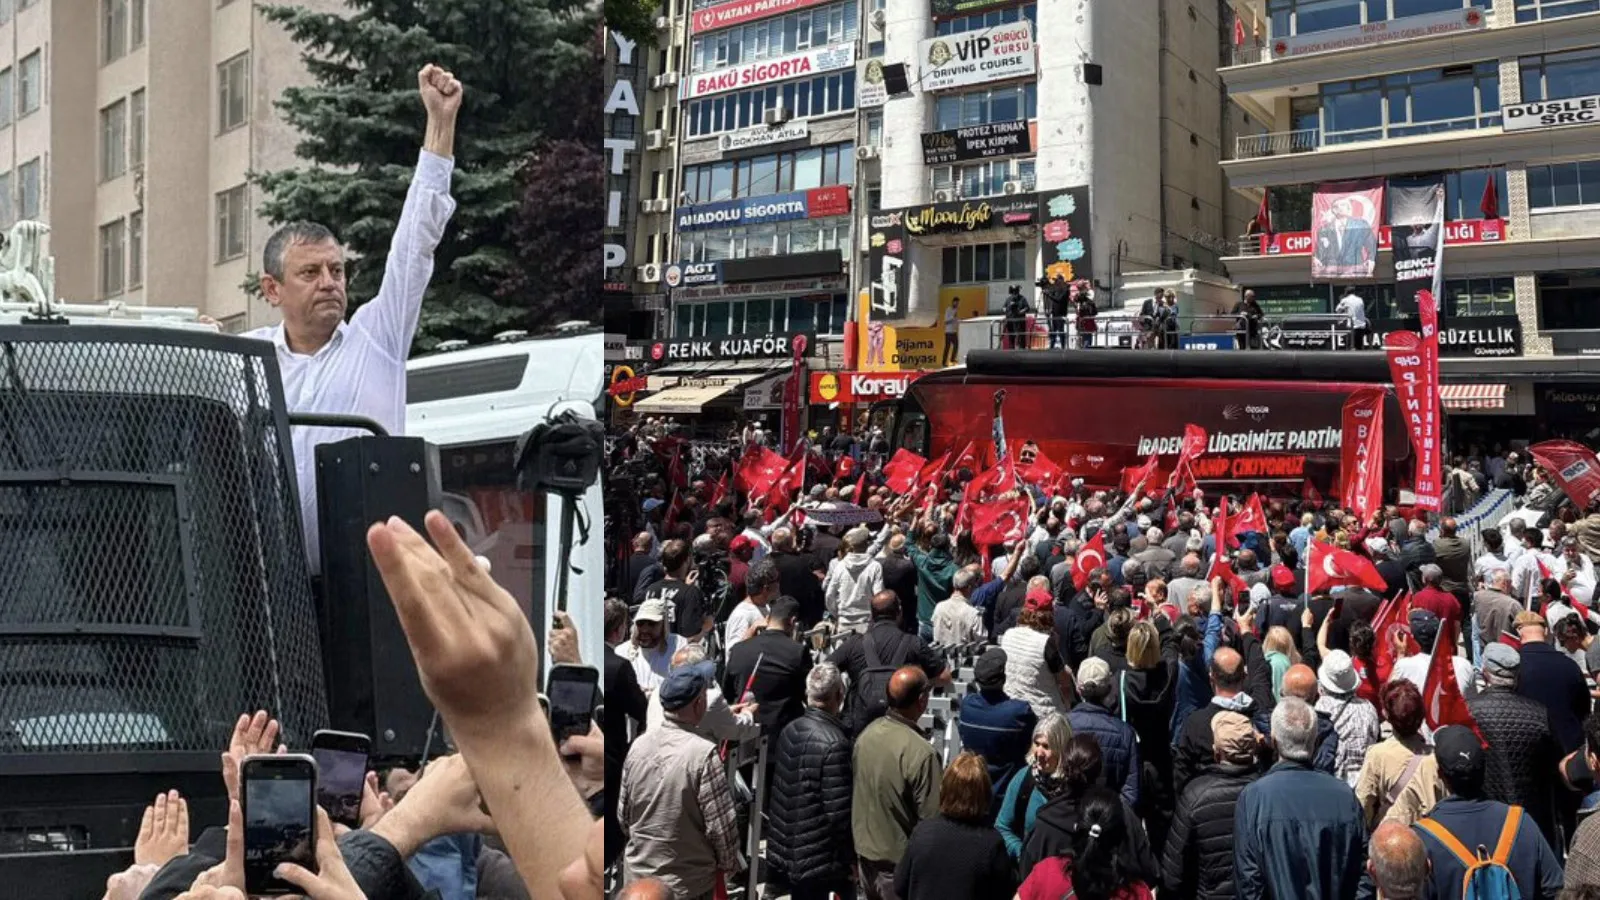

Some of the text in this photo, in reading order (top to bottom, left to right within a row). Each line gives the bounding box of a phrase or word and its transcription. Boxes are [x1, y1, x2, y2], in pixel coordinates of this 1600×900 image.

[717, 5, 752, 20] VATAN
[993, 42, 1029, 56] KURSU
[980, 55, 1023, 71] COURSE
[697, 69, 738, 94] BAKÜ
[741, 57, 811, 84] SİGORTA
[1508, 98, 1600, 118] DÜŞLE
[1540, 110, 1594, 125] SRC
[957, 125, 990, 138] PROTEZ
[744, 201, 805, 219] SİGORTA
[1286, 235, 1312, 249] CHP
[684, 263, 716, 275] AGT
[1395, 257, 1435, 270] GENÇL
[1438, 326, 1514, 345] GÜZELLİK
[668, 334, 788, 358] RENK KUAFÖR
[895, 339, 934, 352] Pijama
[891, 352, 937, 364] Dünyası
[851, 374, 909, 399] Koray
[1137, 425, 1343, 457] İRADEM LİDERİMİZE PARTİM
